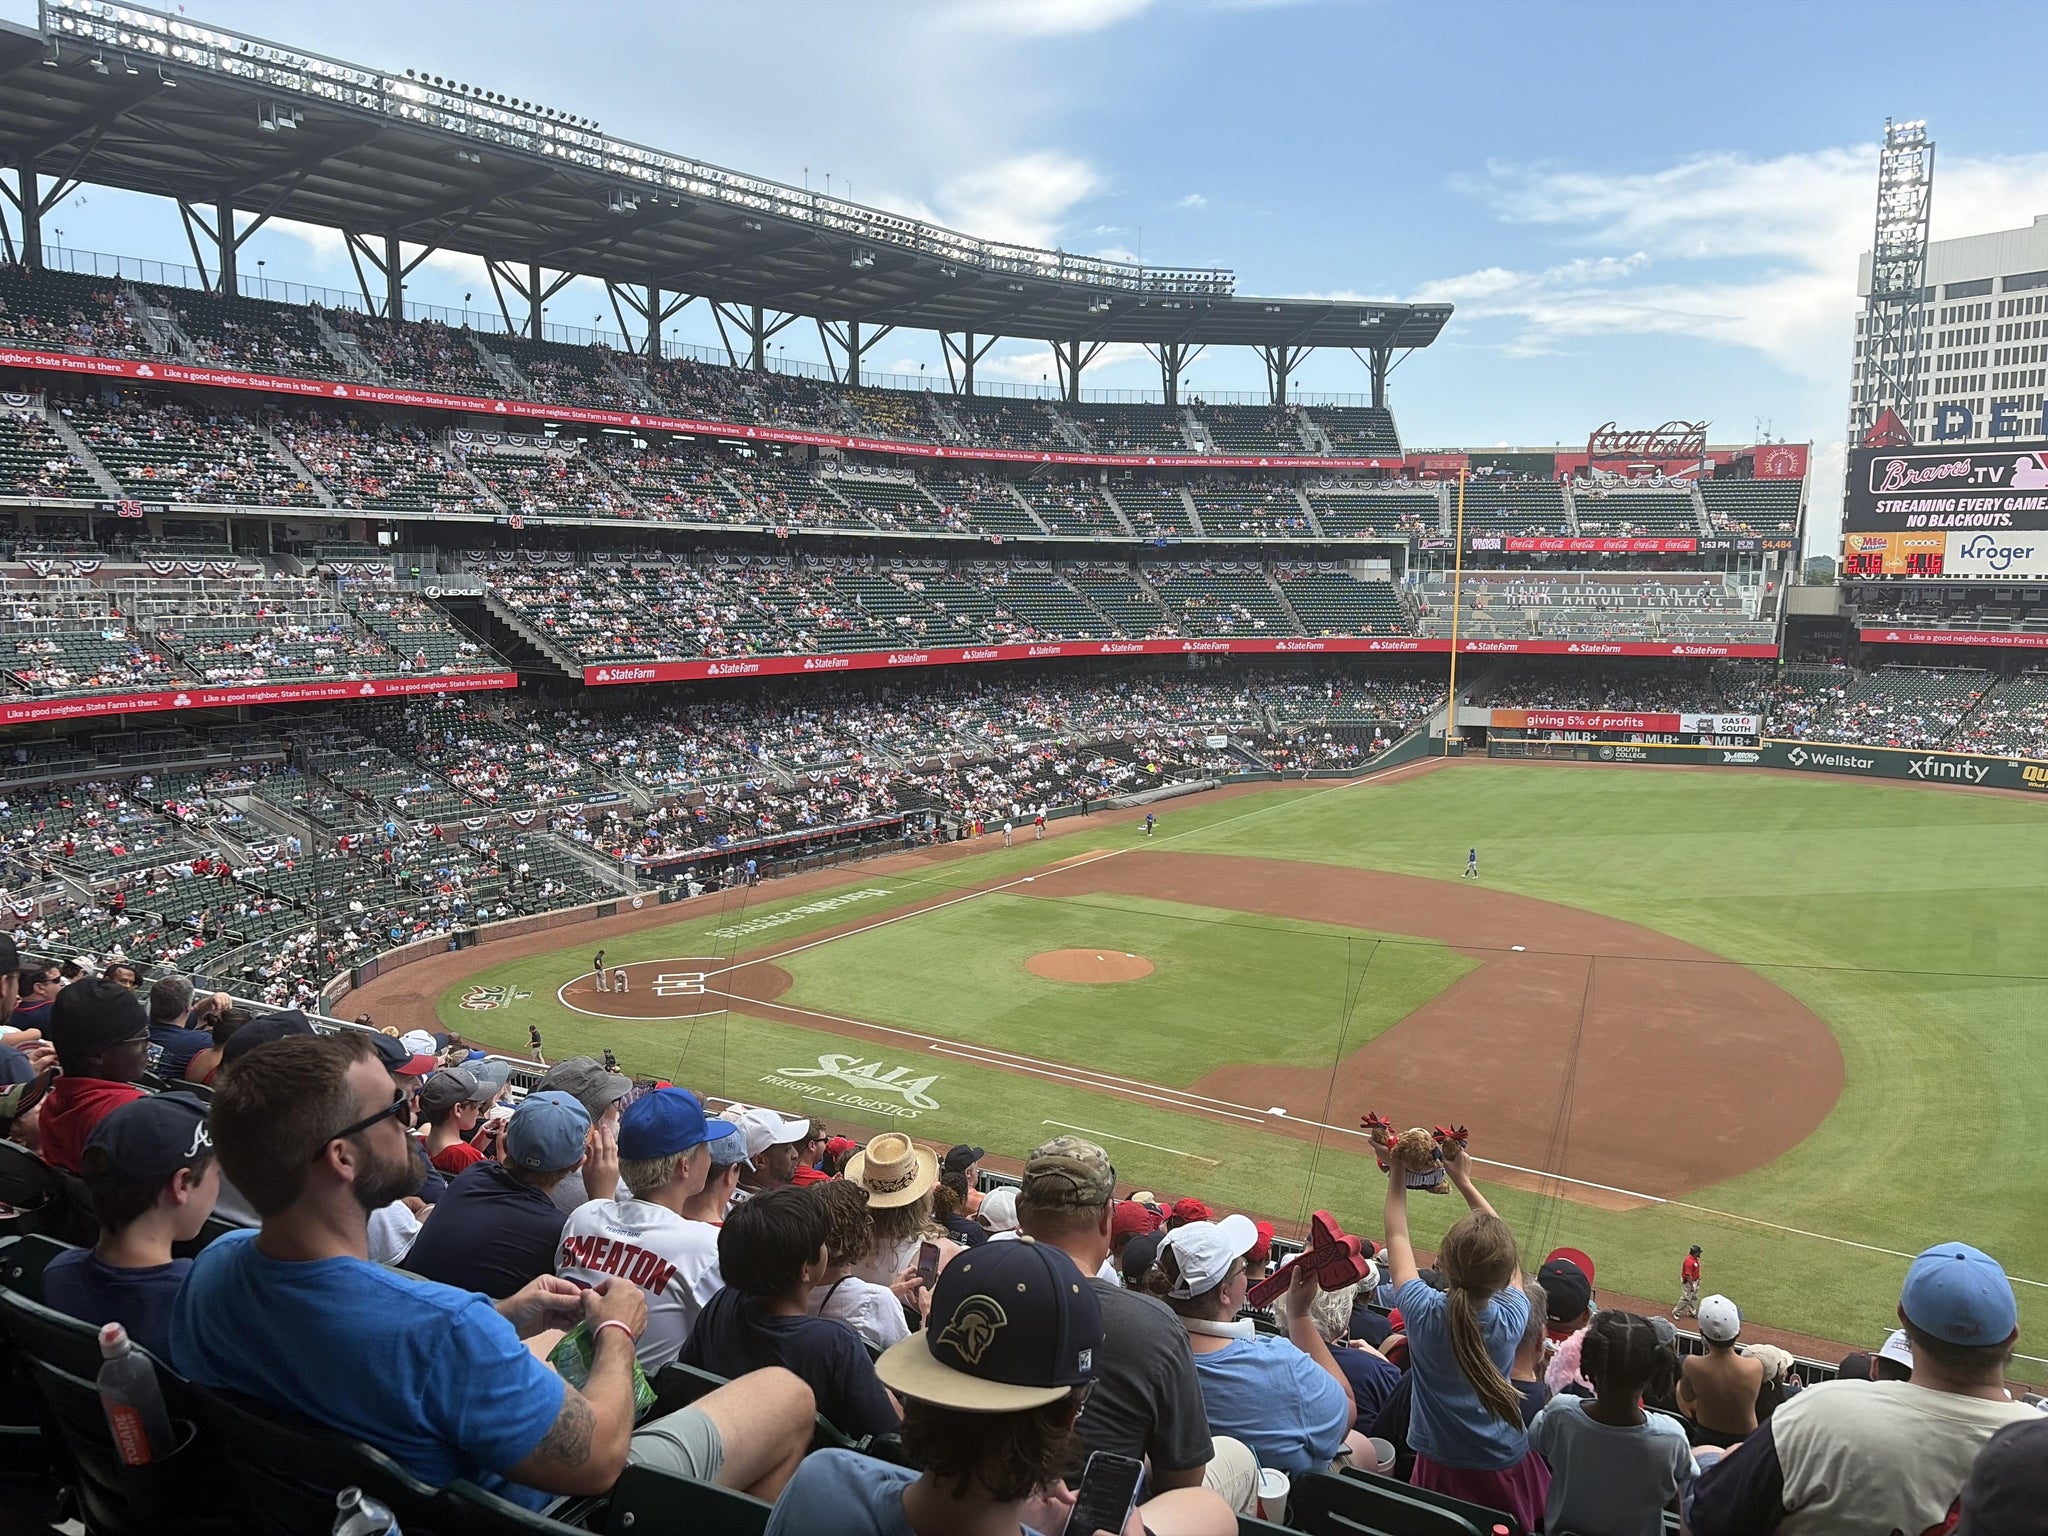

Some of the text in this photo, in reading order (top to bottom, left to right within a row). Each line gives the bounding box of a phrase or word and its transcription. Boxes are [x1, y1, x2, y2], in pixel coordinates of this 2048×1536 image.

[35, 356, 60, 366] State
[62, 359, 86, 368] Farm
[87, 361, 95, 369] is
[164, 369, 182, 377] Like
[249, 378, 271, 387] State
[272, 380, 291, 389] Farm
[1938, 400, 2048, 440] DE
[117, 500, 143, 518] 35
[1876, 500, 1957, 513] STREAMING
[1957, 498, 2005, 512] EVERY
[509, 515, 525, 529] 41
[1906, 513, 2013, 527] NO BLACKOUTS.
[1154, 536, 1168, 548] 42
[1700, 541, 1716, 549] 1:53
[1717, 541, 1730, 549] PM
[1762, 540, 1792, 549] $4,484
[1862, 537, 1887, 546] MEGA
[1960, 535, 2035, 571] Kroger
[441, 588, 483, 596] LEXUS
[1506, 586, 1724, 607] HANK AARON TERRACE
[1909, 633, 1925, 641] Like
[1933, 634, 1952, 643] good
[1991, 636, 2012, 644] State
[2037, 637, 2044, 645] is
[227, 694, 245, 702] good
[32, 708, 51, 717] good
[90, 702, 111, 710] State
[1527, 714, 1644, 730] giving 5% of profits
[1720, 716, 1741, 725] GAS
[1721, 724, 1751, 733] SOUTH
[1564, 731, 1598, 742] MLB+
[1645, 734, 1680, 745] MLB+
[1715, 736, 1752, 747] MLB+
[1811, 752, 1875, 770] Wellstar
[1907, 756, 1990, 783] xfinity
[758, 1074, 826, 1097] FREIGHT
[837, 1093, 924, 1119] LOGISTICS
[183, 1120, 213, 1158] A
[605, 1225, 642, 1239] PERFECT GAME
[560, 1235, 678, 1296] SMEATON
